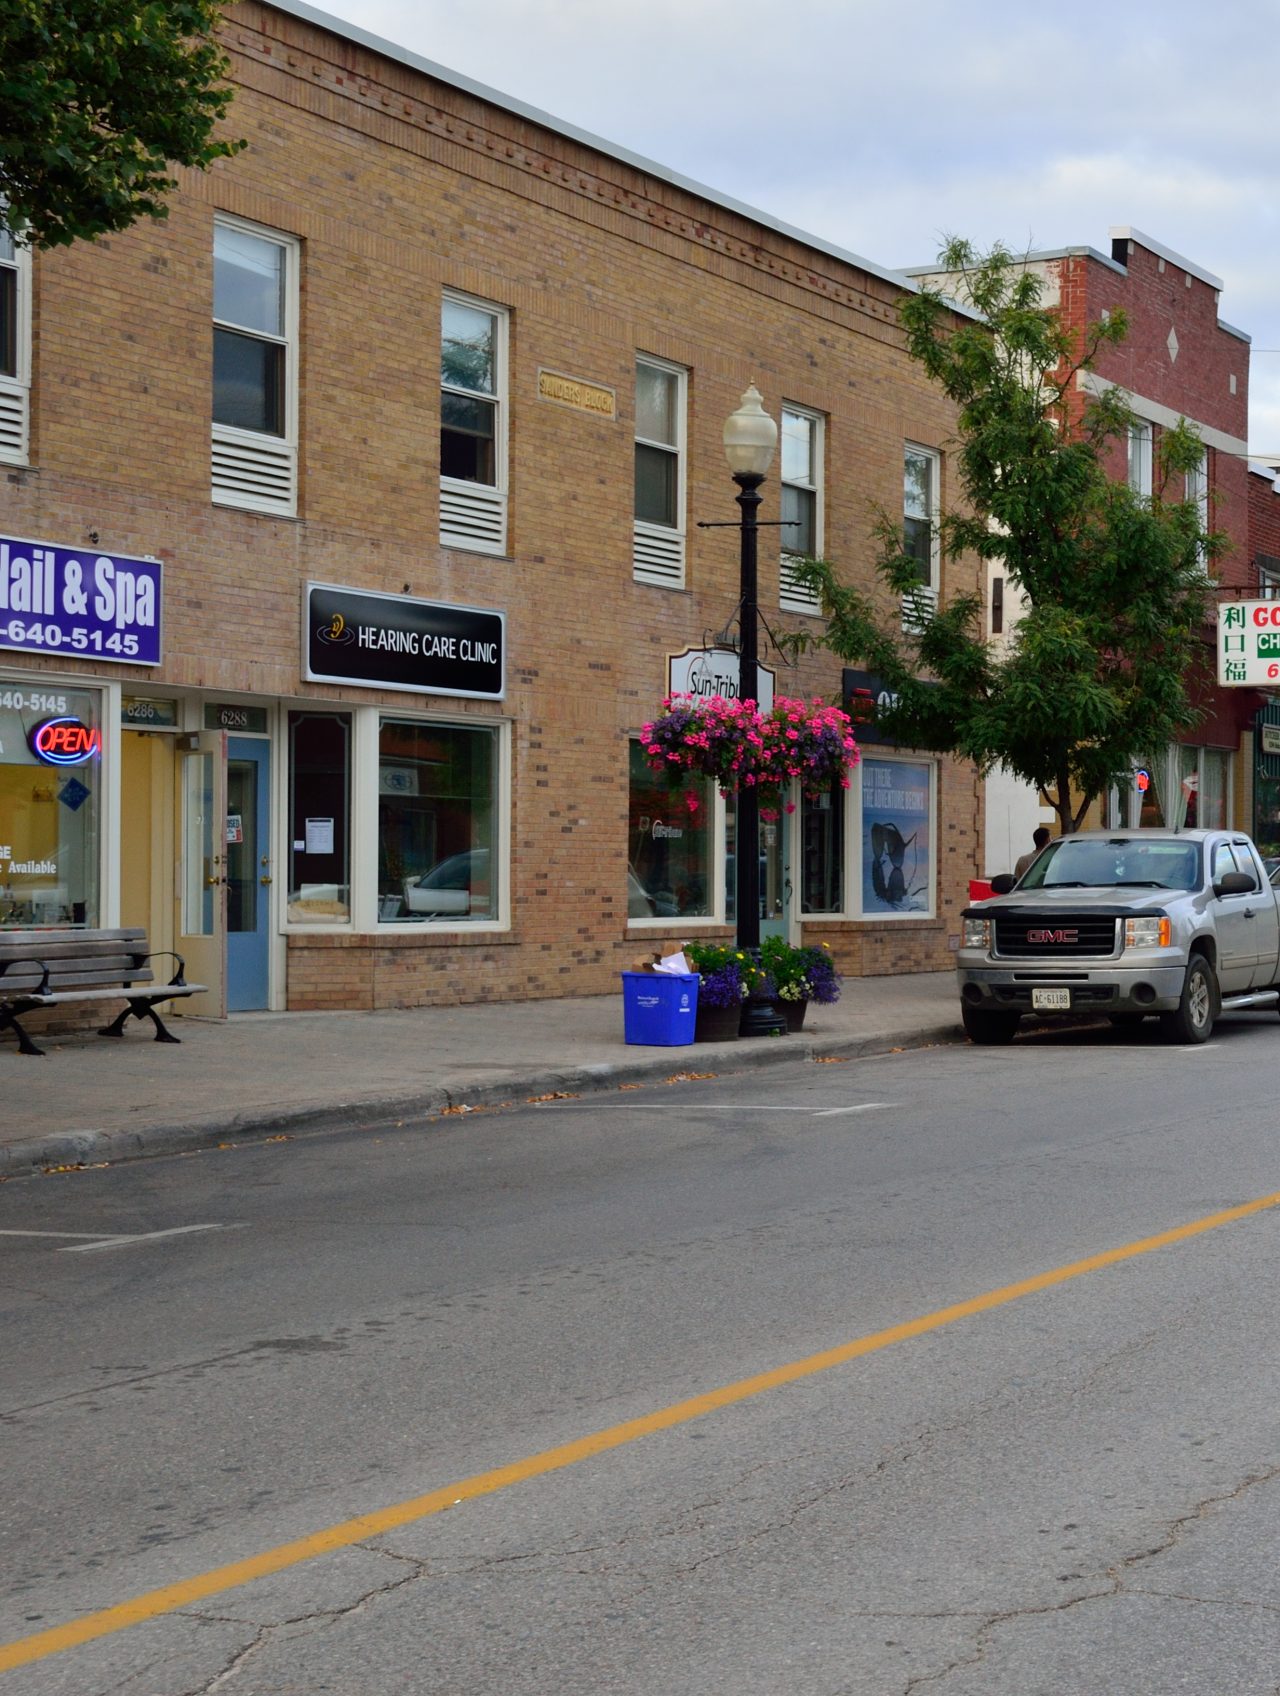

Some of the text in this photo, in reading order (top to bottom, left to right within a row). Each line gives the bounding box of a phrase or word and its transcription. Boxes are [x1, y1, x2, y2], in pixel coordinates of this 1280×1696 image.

[62, 559, 88, 615] &
[94, 557, 155, 630] Spa
[358, 626, 497, 664] HEARING CARE CLINIC
[1223, 606, 1247, 682] 利口福
[690, 671, 741, 700] Sun-Tribu
[0, 691, 67, 713] 40-5145
[127, 703, 154, 718] 6286
[221, 710, 248, 726] 6288
[40, 726, 96, 752] OPEN
[8, 860, 57, 874] Available
[1027, 929, 1079, 943] GMC
